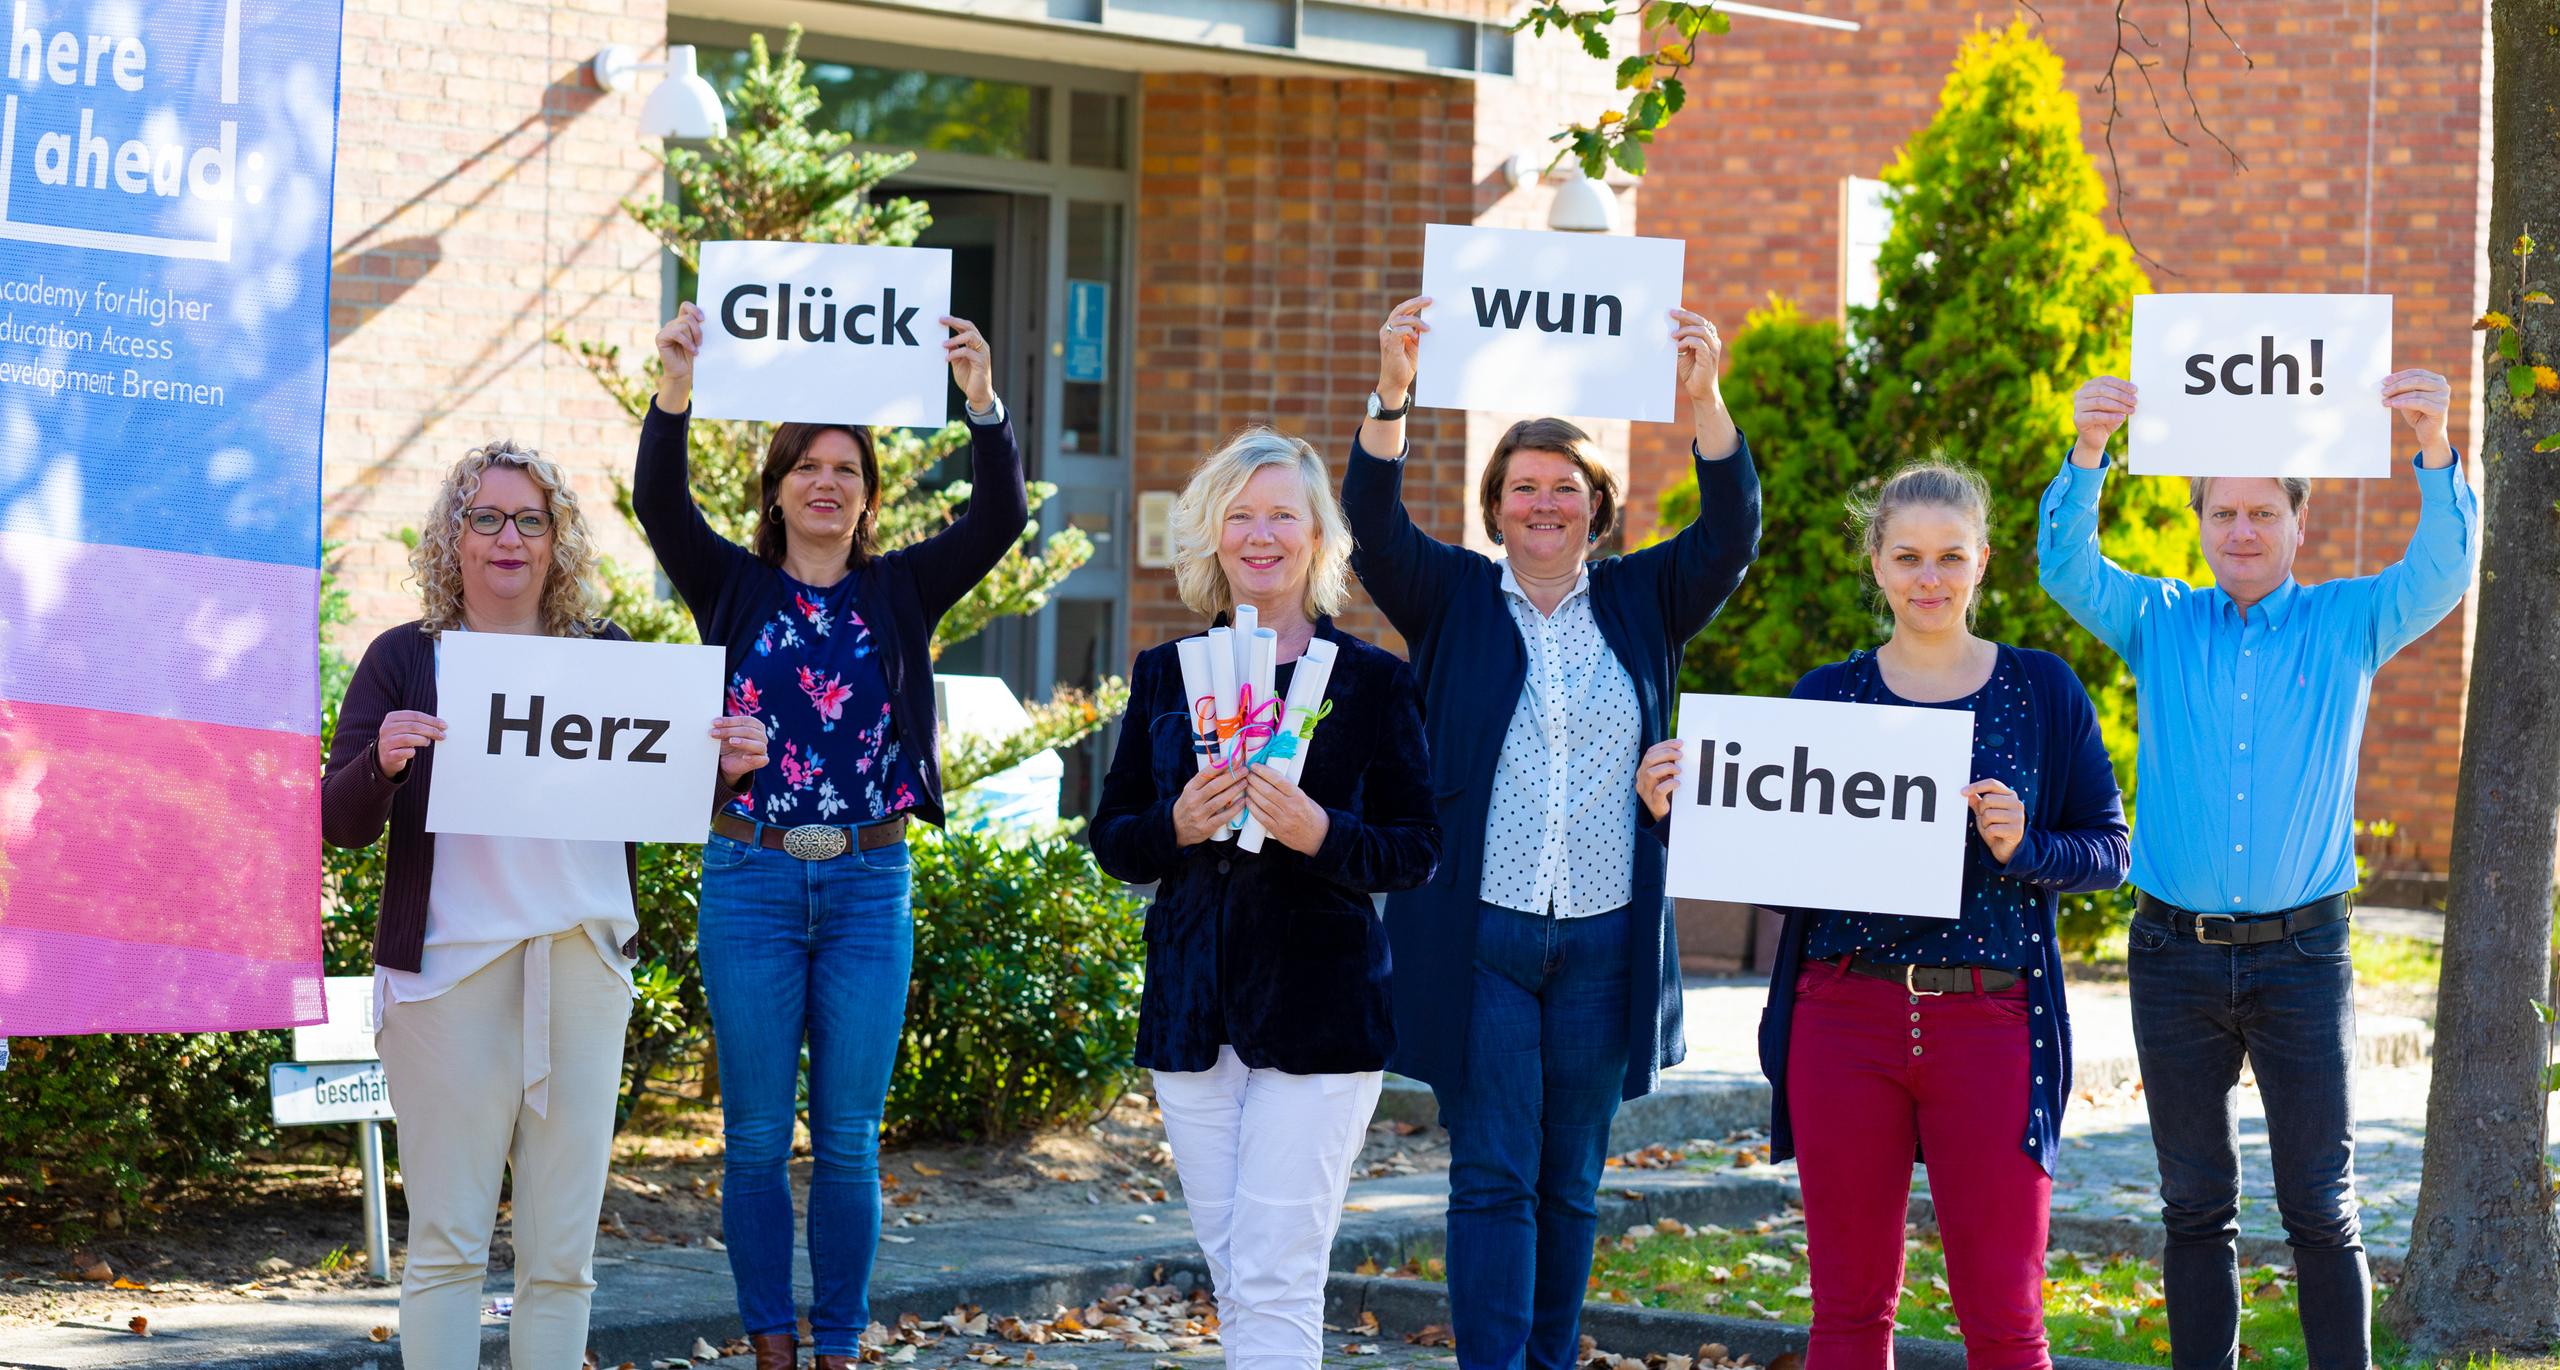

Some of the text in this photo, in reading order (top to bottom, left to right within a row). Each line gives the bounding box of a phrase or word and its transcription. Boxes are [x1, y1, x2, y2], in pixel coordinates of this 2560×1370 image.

[8, 0, 147, 92] here
[34, 108, 265, 204] ahead:
[95, 281, 125, 312] for
[126, 287, 213, 328] Higher
[720, 282, 920, 347] Glück
[1471, 286, 1623, 337] wun
[0, 312, 173, 360] ducation Access
[2184, 335, 2324, 396] sch!
[0, 356, 225, 406] evelopment Bremen
[486, 692, 671, 764] Herz
[1696, 739, 1937, 823] lichen
[315, 1073, 388, 1105] Geschäf
